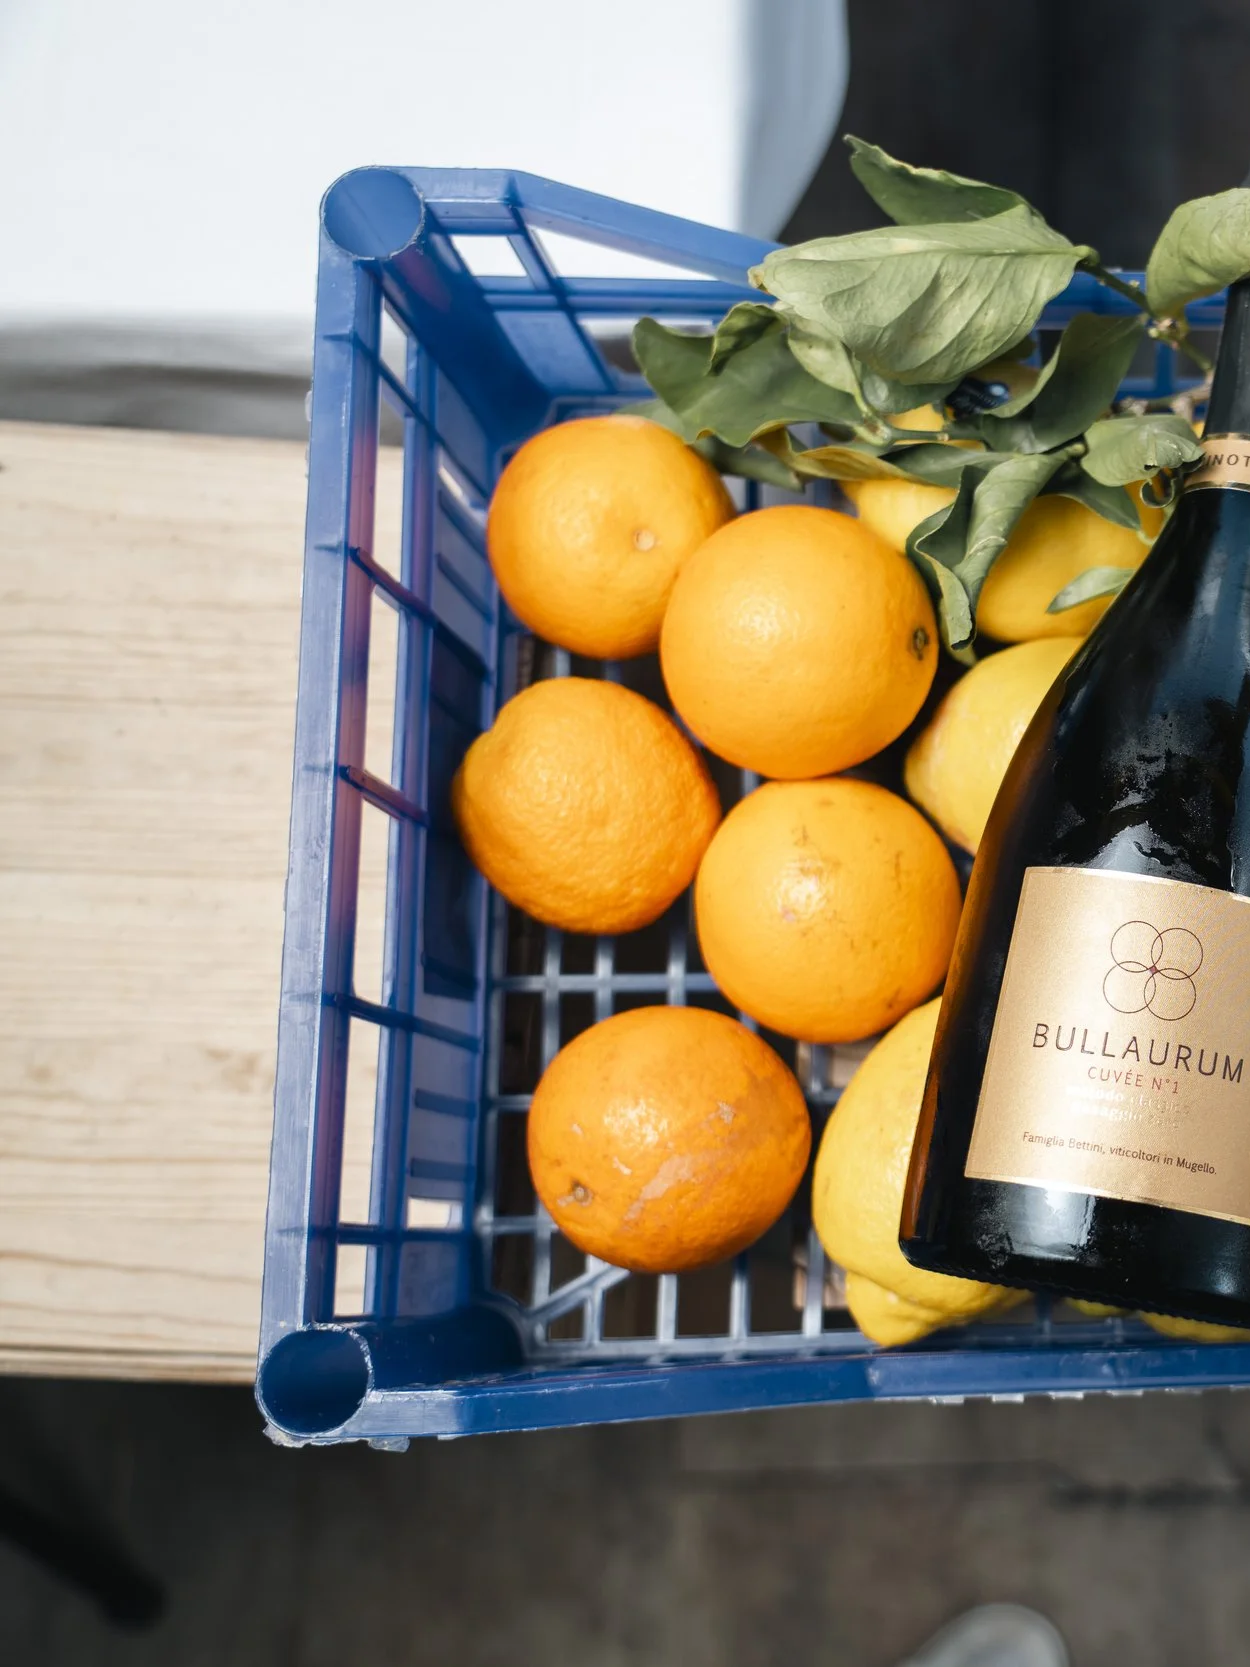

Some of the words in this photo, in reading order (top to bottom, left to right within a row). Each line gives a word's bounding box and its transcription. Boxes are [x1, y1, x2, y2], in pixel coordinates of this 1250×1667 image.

[1032, 1023, 1244, 1083] BULLAURUM
[1087, 1065, 1144, 1088] CUVÉE
[1022, 1131, 1065, 1148] Famiglia
[1068, 1138, 1106, 1155] Bettini,
[1109, 1145, 1160, 1164] viticoltori
[1163, 1156, 1174, 1166] in
[1176, 1156, 1218, 1175] Mugello.
